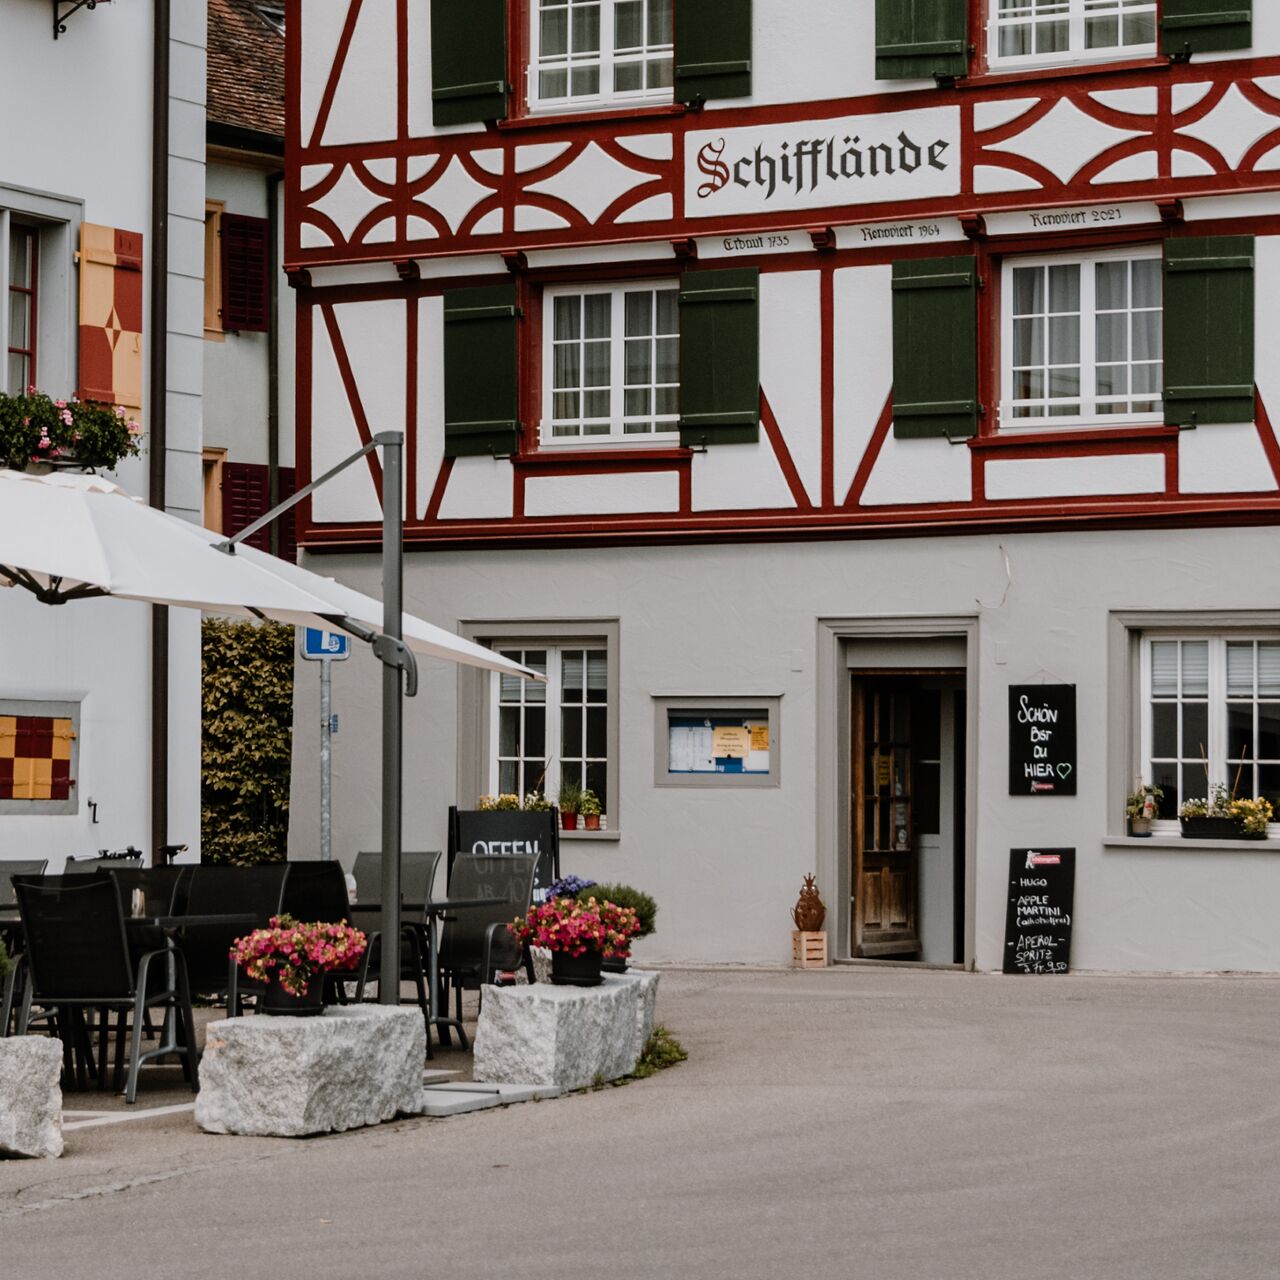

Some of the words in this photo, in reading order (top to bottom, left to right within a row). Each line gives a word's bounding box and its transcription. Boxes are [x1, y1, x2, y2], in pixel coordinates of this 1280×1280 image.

[695, 130, 950, 200] Schifflände
[1029, 210, 1086, 227] Renoviert
[1091, 208, 1122, 222] 2021
[860, 224, 914, 241] Renoviert
[918, 224, 940, 238] 1964
[723, 235, 763, 251] Erbaut
[767, 235, 790, 249] 1735
[1024, 762, 1055, 778] HIER
[1019, 877, 1048, 887] HUGO
[1017, 895, 1049, 906] APPLE
[1017, 906, 1061, 916] MARTINI
